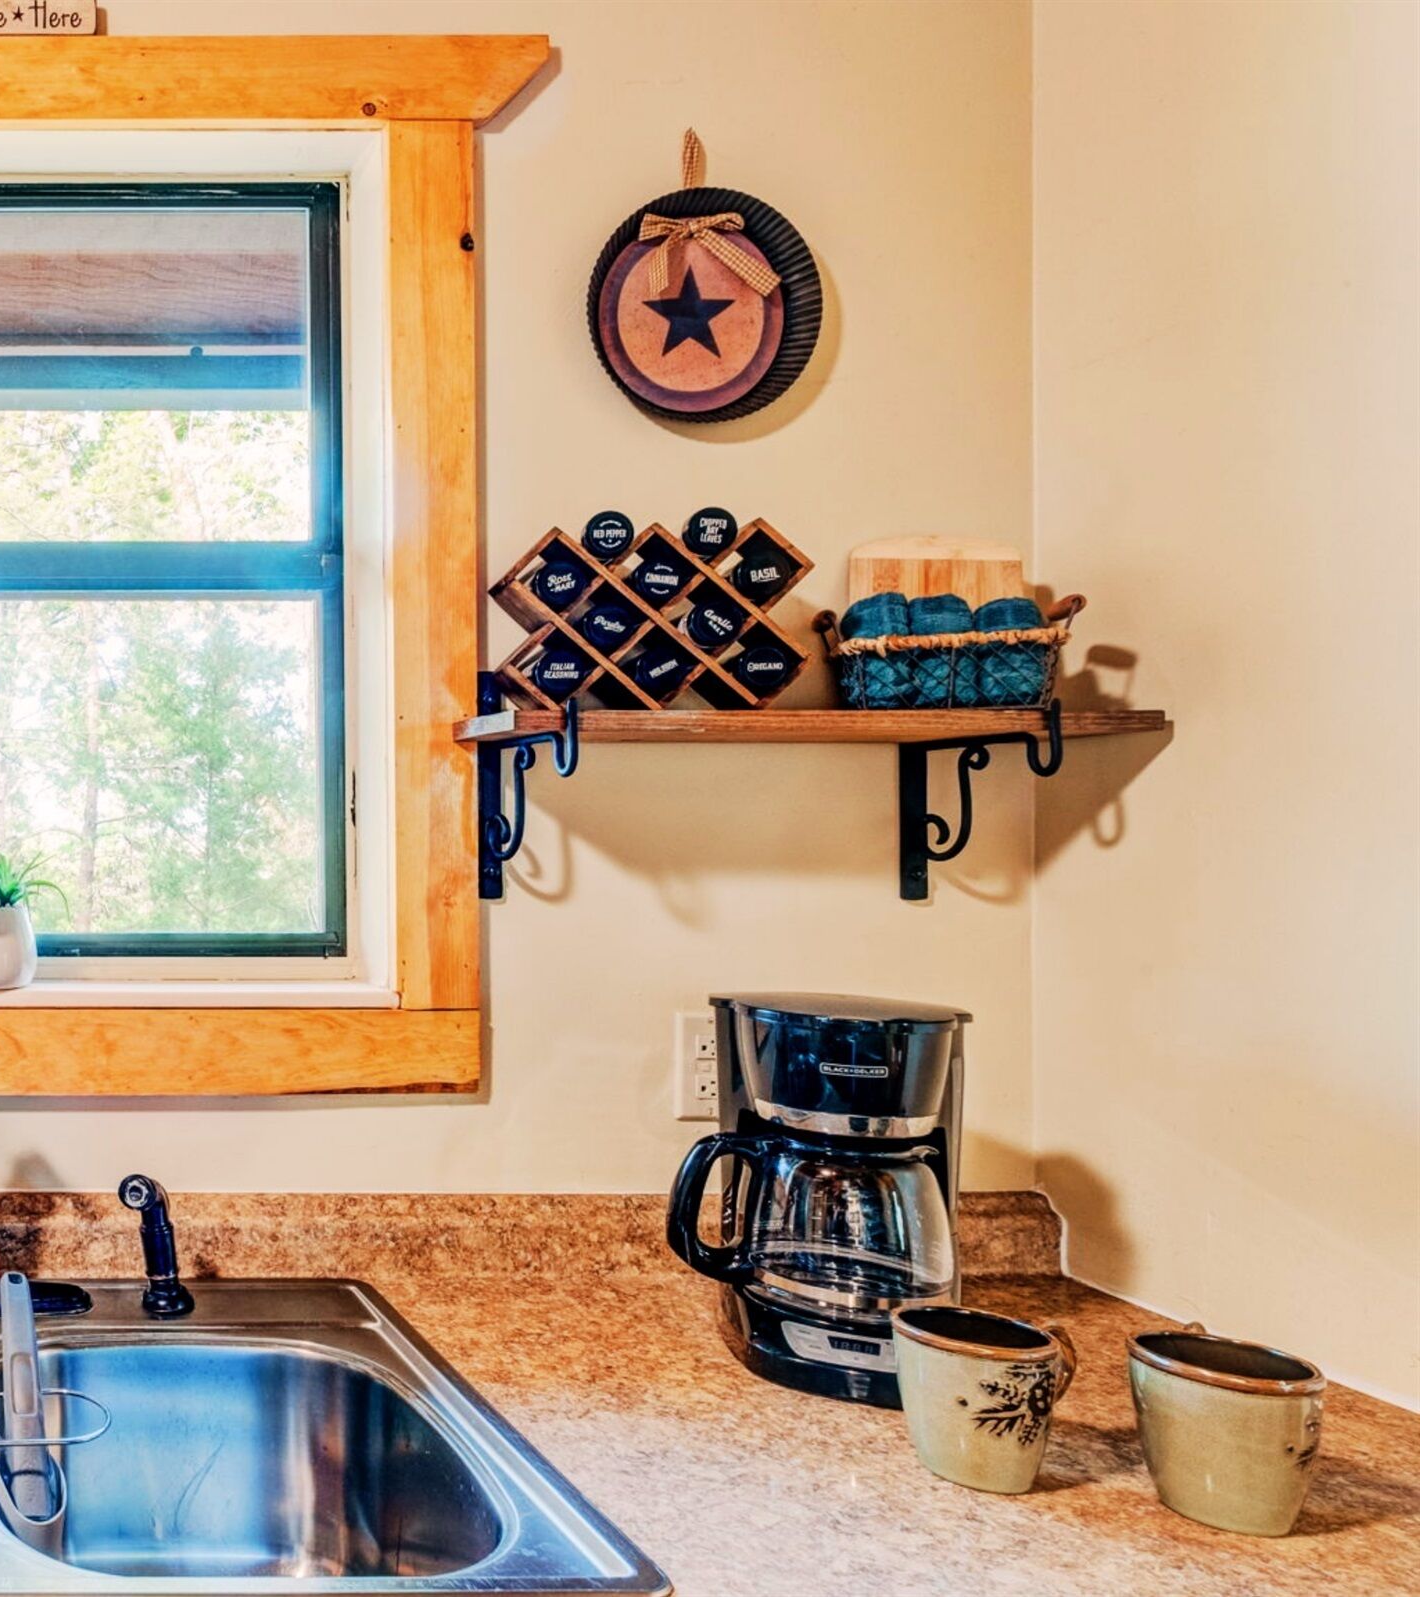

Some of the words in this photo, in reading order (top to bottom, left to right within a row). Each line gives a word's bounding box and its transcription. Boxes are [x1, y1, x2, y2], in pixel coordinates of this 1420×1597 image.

[28, 0, 82, 29] Here
[593, 529, 605, 538] RED
[606, 528, 627, 538] PEPPER
[645, 572, 679, 586] CINNAMON
[750, 566, 780, 583] BASIL
[747, 661, 784, 672] OREGANO
